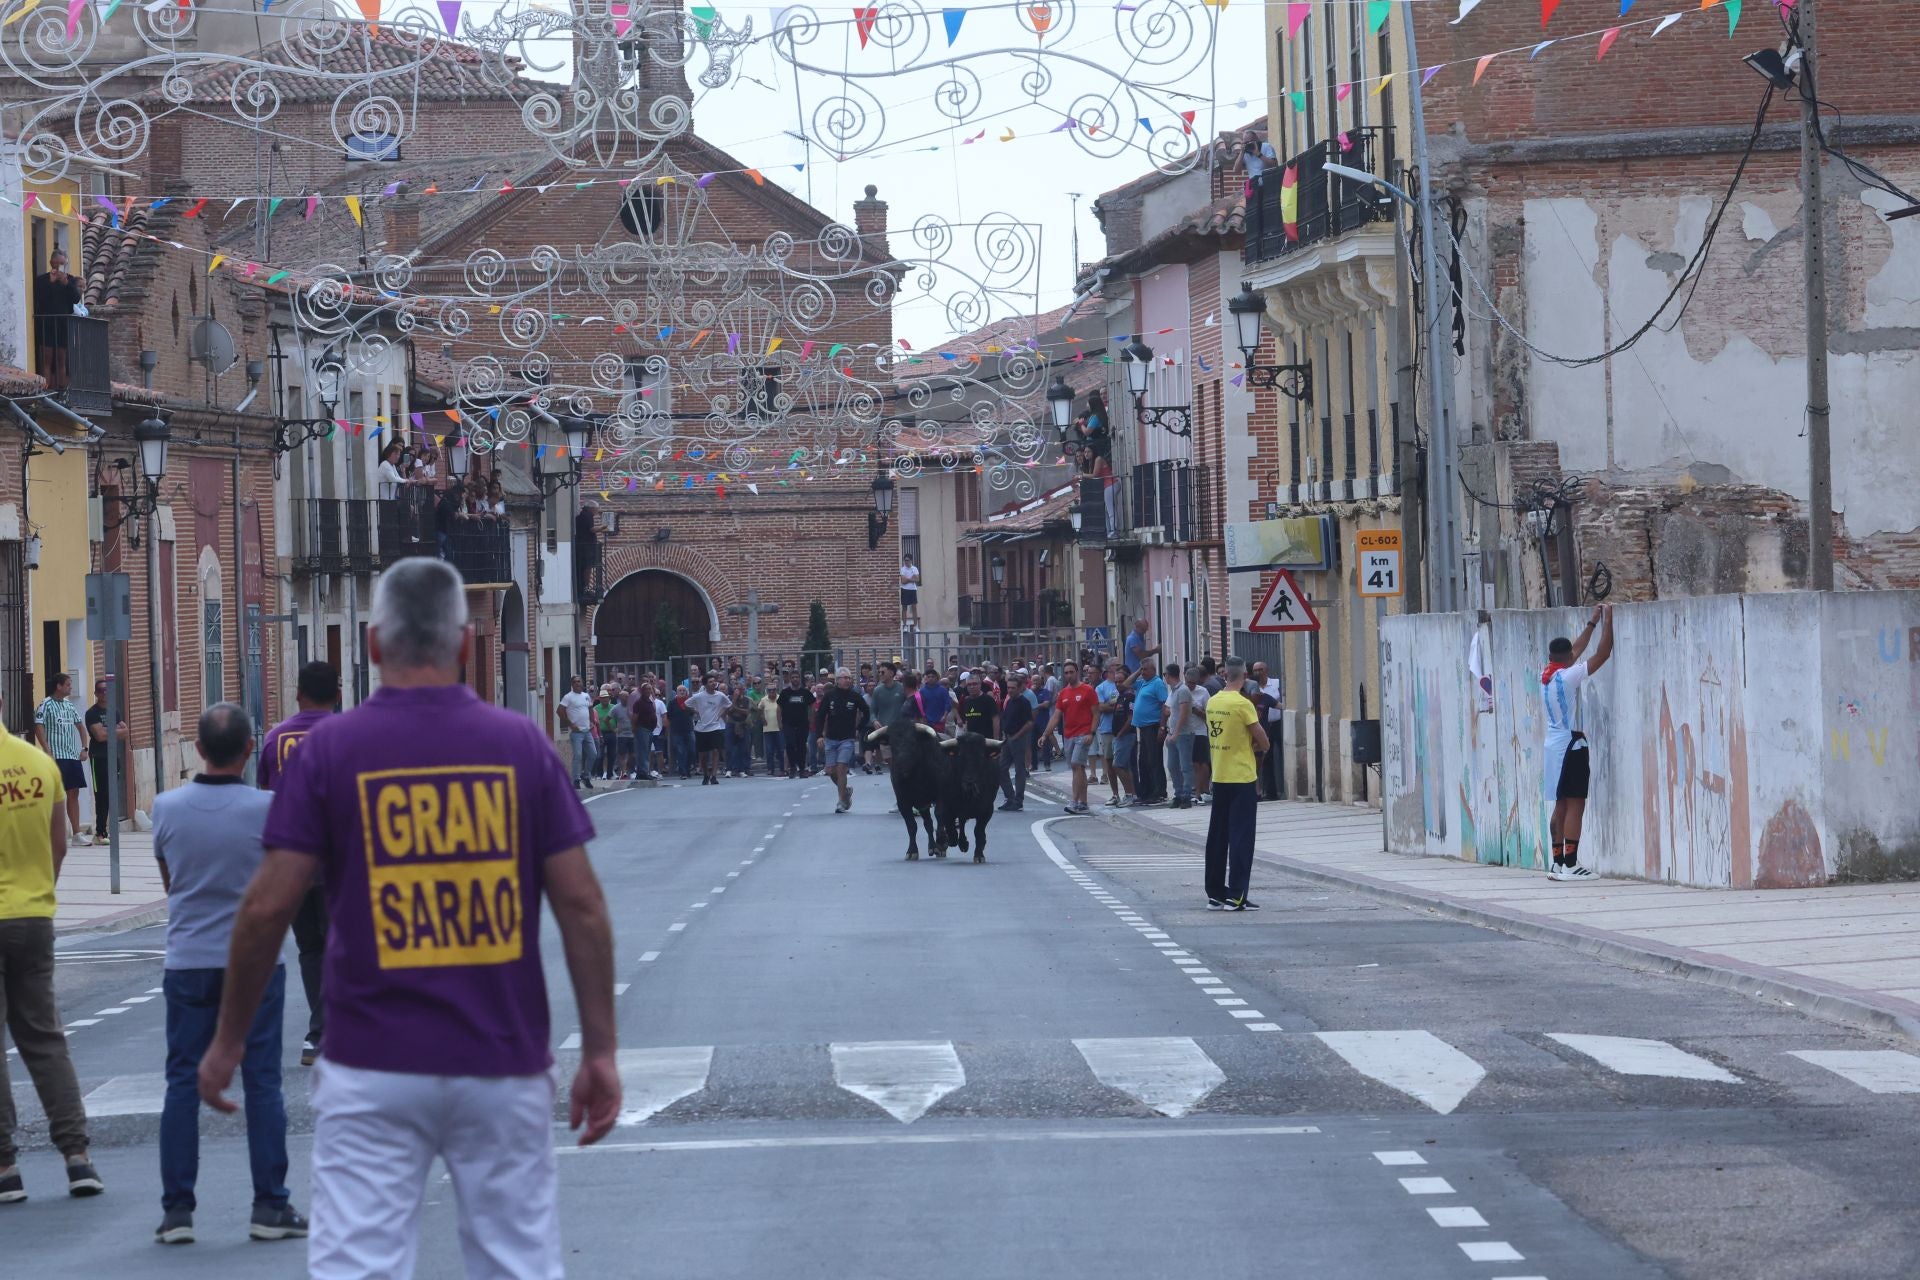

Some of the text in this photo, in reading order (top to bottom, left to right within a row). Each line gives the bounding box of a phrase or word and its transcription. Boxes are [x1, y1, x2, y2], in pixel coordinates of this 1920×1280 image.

[1226, 524, 1237, 566] CORREOS
[1371, 556, 1389, 566] km
[1368, 570, 1394, 588] 41
[376, 780, 508, 858] GRAN
[379, 877, 516, 951] SARAO
